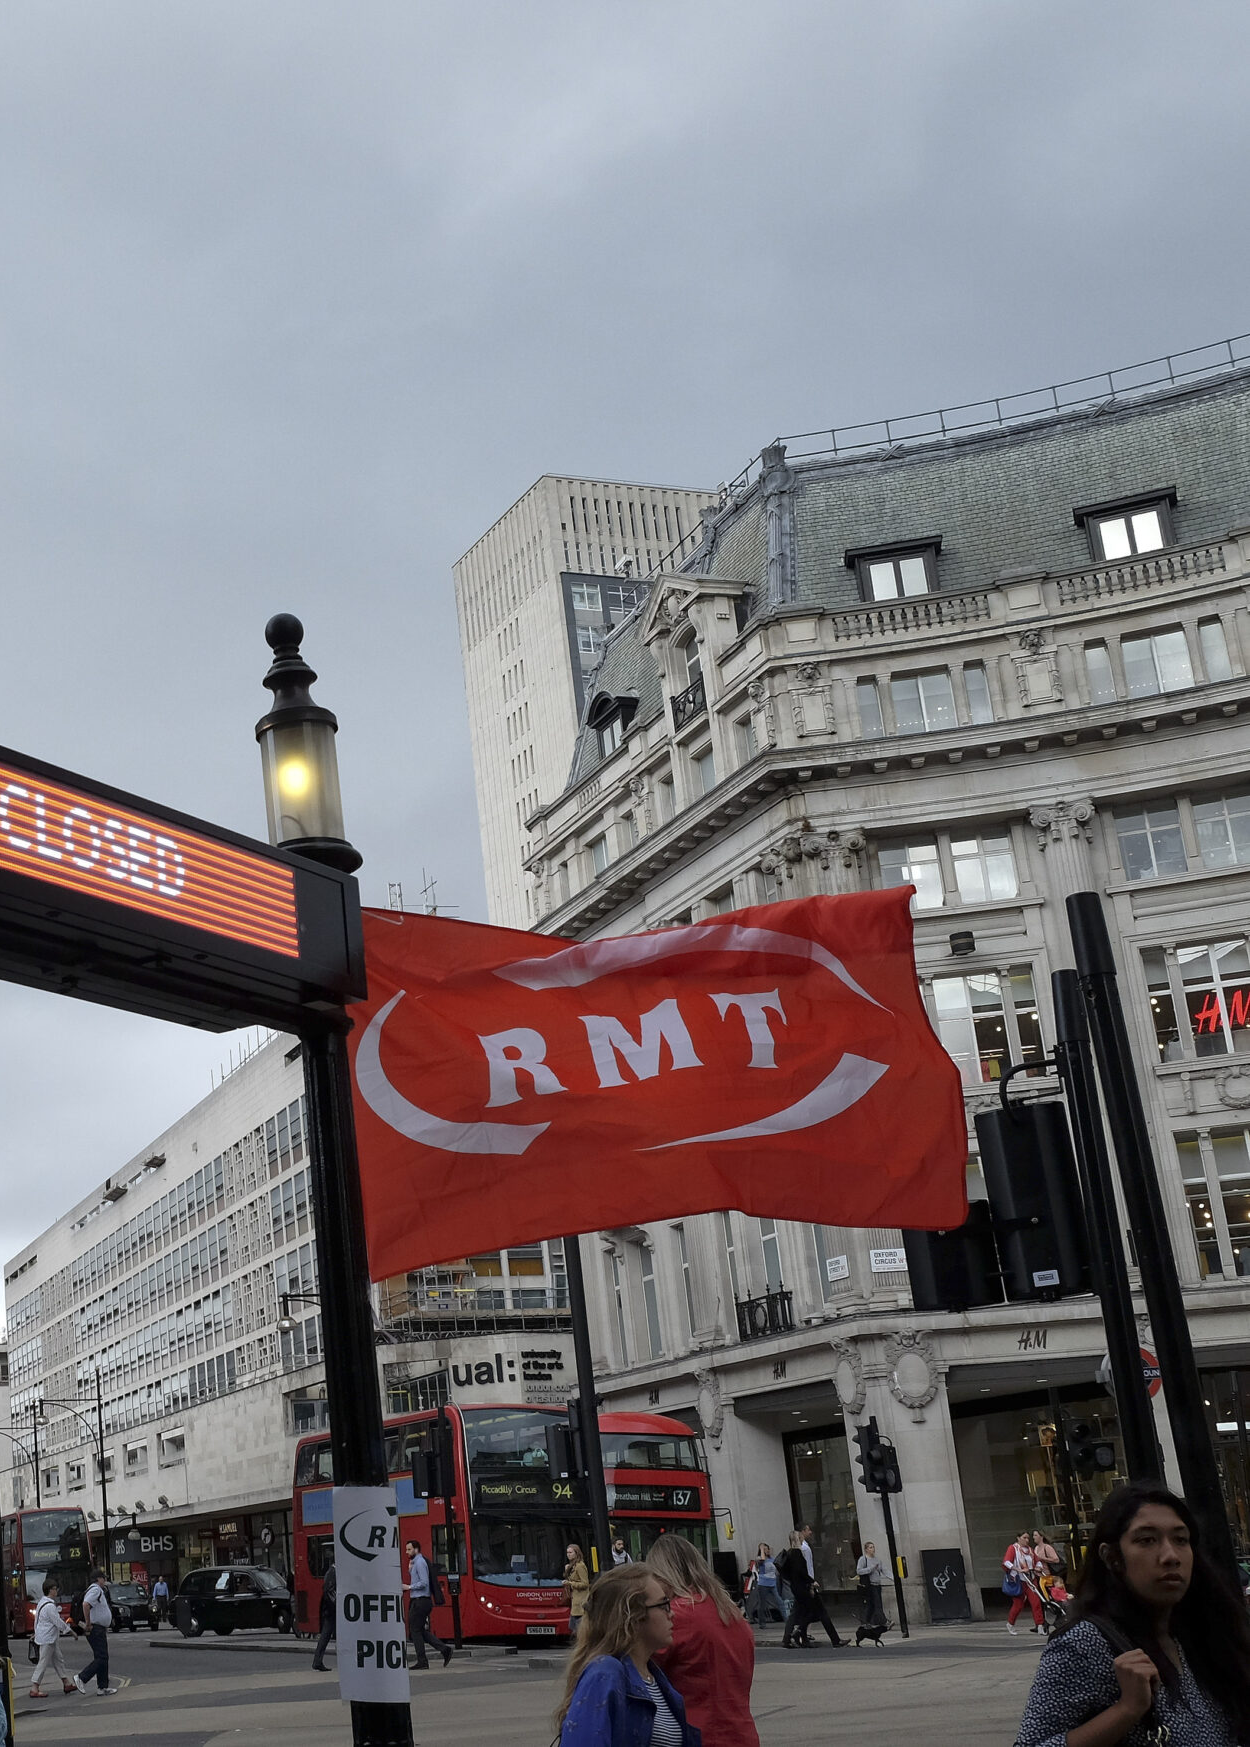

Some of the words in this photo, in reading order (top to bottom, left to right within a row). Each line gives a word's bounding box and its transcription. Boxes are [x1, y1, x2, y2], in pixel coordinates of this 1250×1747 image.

[0, 784, 185, 896] CLOSED
[477, 988, 788, 1108] RMT
[521, 1349, 562, 1360] university
[522, 1360, 532, 1370] of
[532, 1360, 546, 1370] the
[547, 1361, 564, 1370] arts
[523, 1371, 552, 1381] london
[481, 1485, 512, 1495] Piccadilly
[515, 1485, 537, 1493] Circus
[552, 1483, 573, 1499] 94
[673, 1490, 691, 1505] 137
[115, 1539, 125, 1555] BHS
[140, 1535, 174, 1553] BHS
[70, 1547, 81, 1558] 23
[132, 1573, 148, 1582] SALE
[343, 1593, 406, 1623] OFFI
